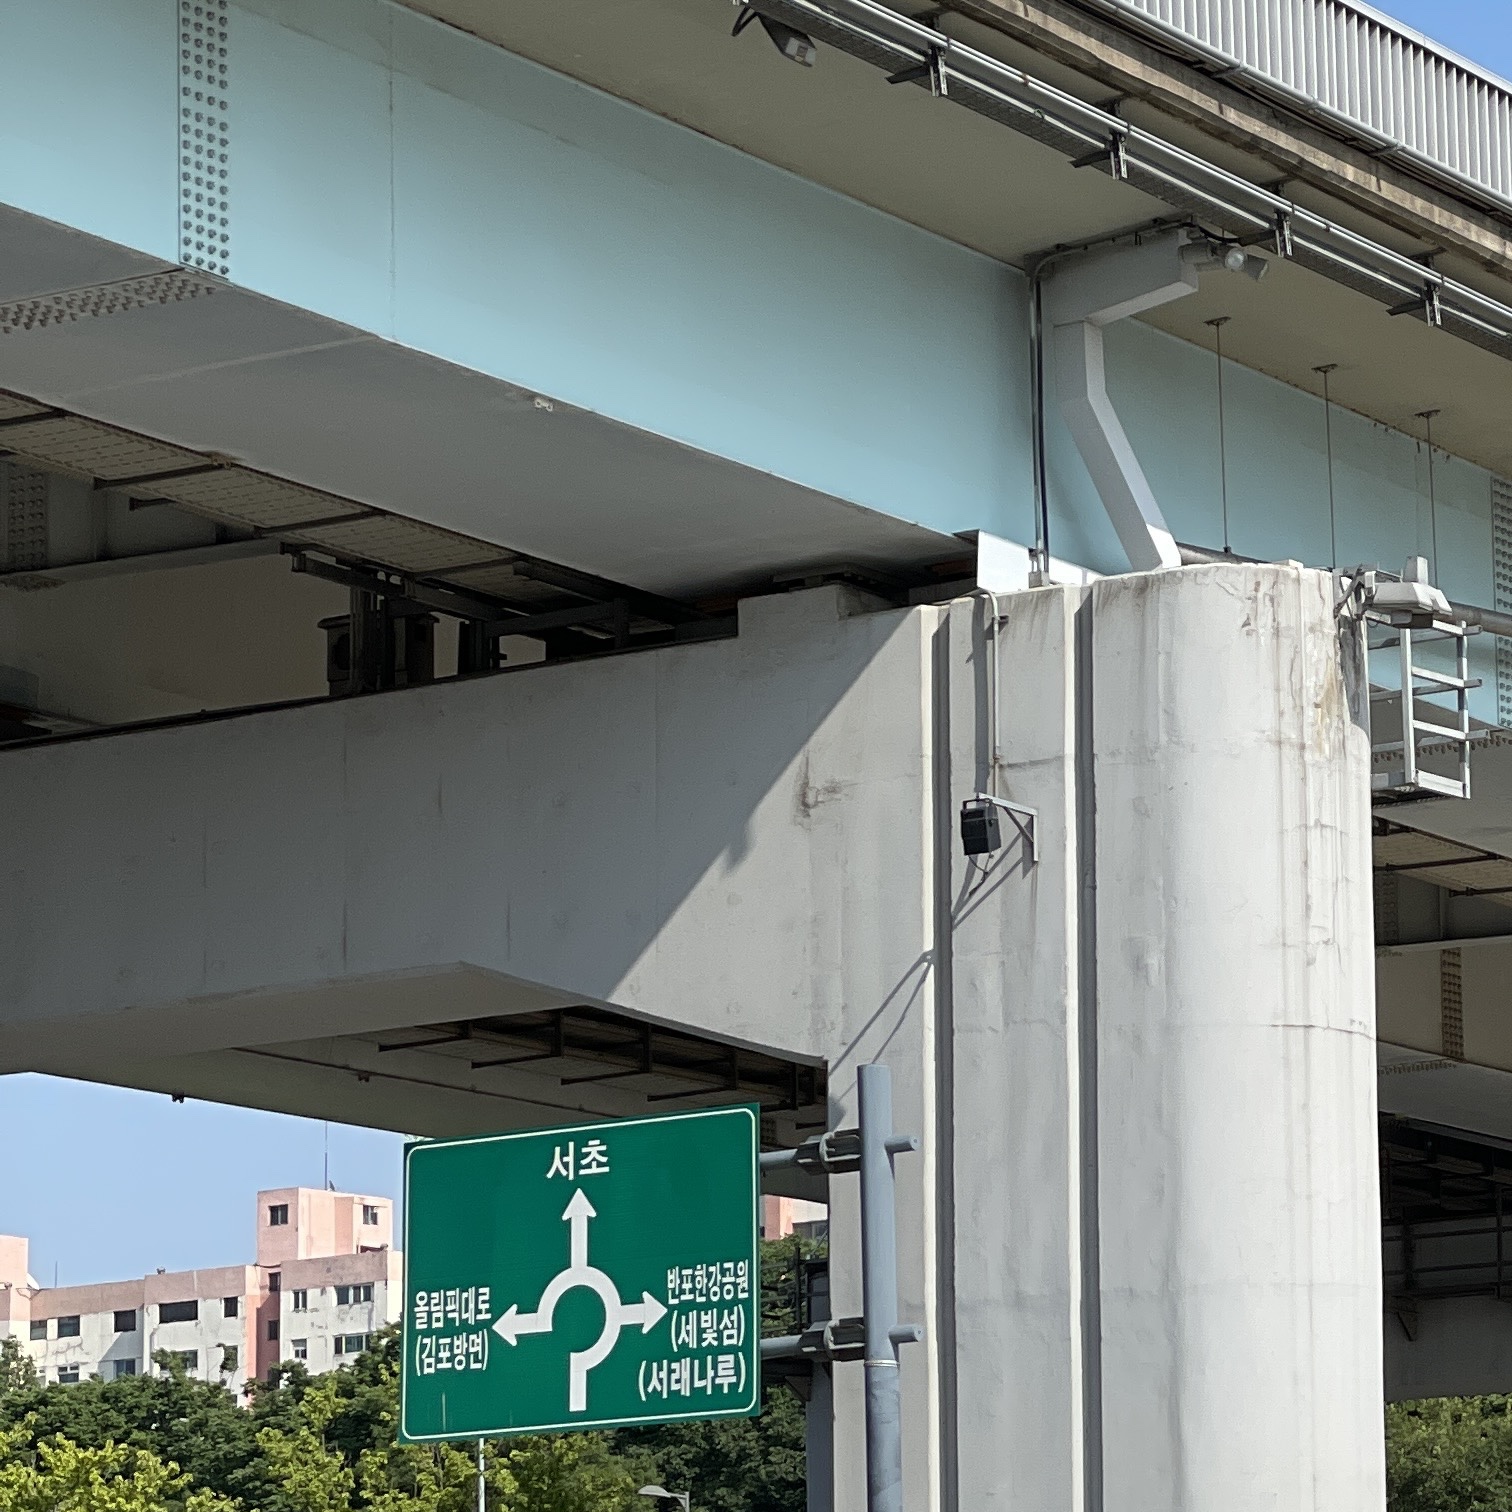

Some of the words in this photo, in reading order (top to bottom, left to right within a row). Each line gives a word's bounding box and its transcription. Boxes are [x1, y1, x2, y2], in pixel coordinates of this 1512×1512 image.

[546, 1139, 610, 1180] 서초
[666, 1259, 750, 1305] 반포한강공원
[413, 1286, 492, 1330] 올림픽대로
[670, 1304, 746, 1352] (세빛섬)
[415, 1329, 489, 1376] (김포방면)
[638, 1352, 746, 1402] (서래나루)
